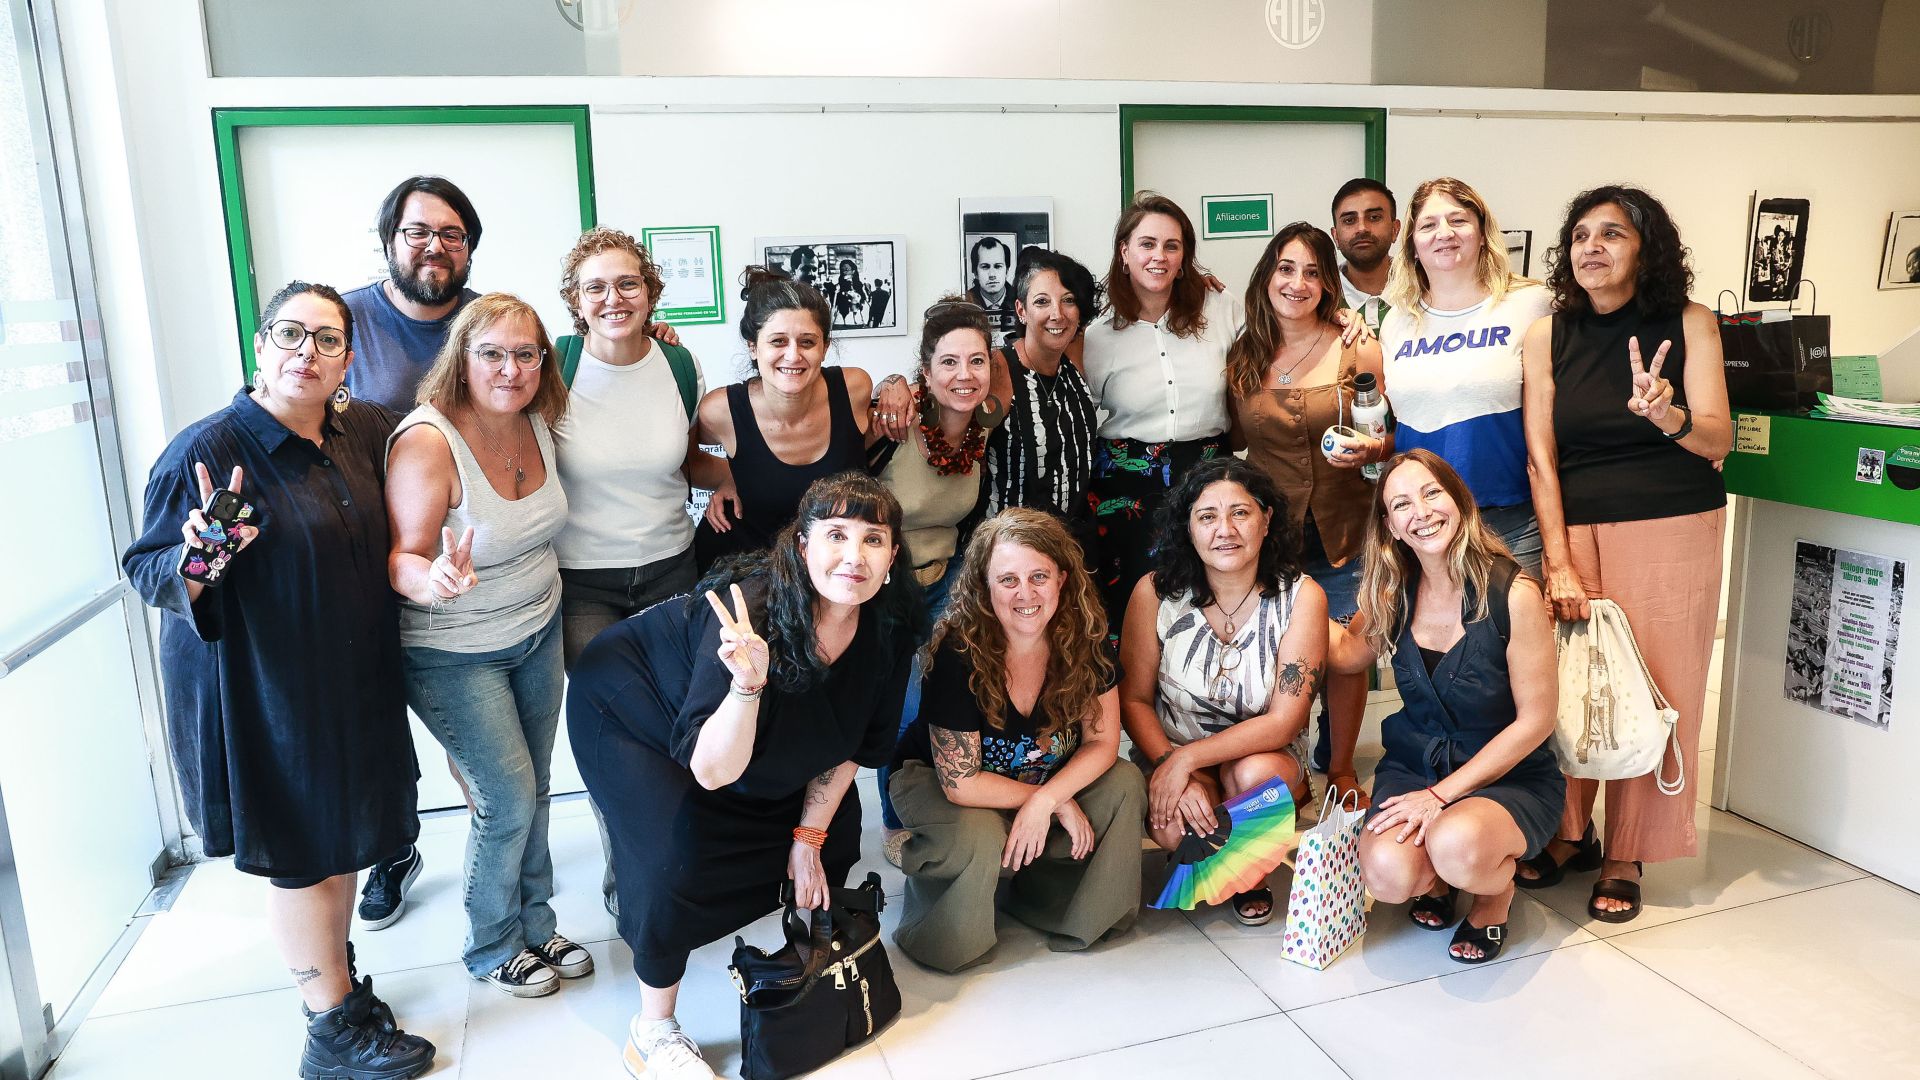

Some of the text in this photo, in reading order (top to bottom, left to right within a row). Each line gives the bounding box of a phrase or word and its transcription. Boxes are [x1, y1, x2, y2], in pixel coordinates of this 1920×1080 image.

[1215, 212, 1260, 222] Afiliaciones
[1393, 326, 1511, 361] AMOUR
[1724, 360, 1750, 368] SPRESSO
[1865, 567, 1884, 578] entre
[1833, 672, 1839, 681] 5
